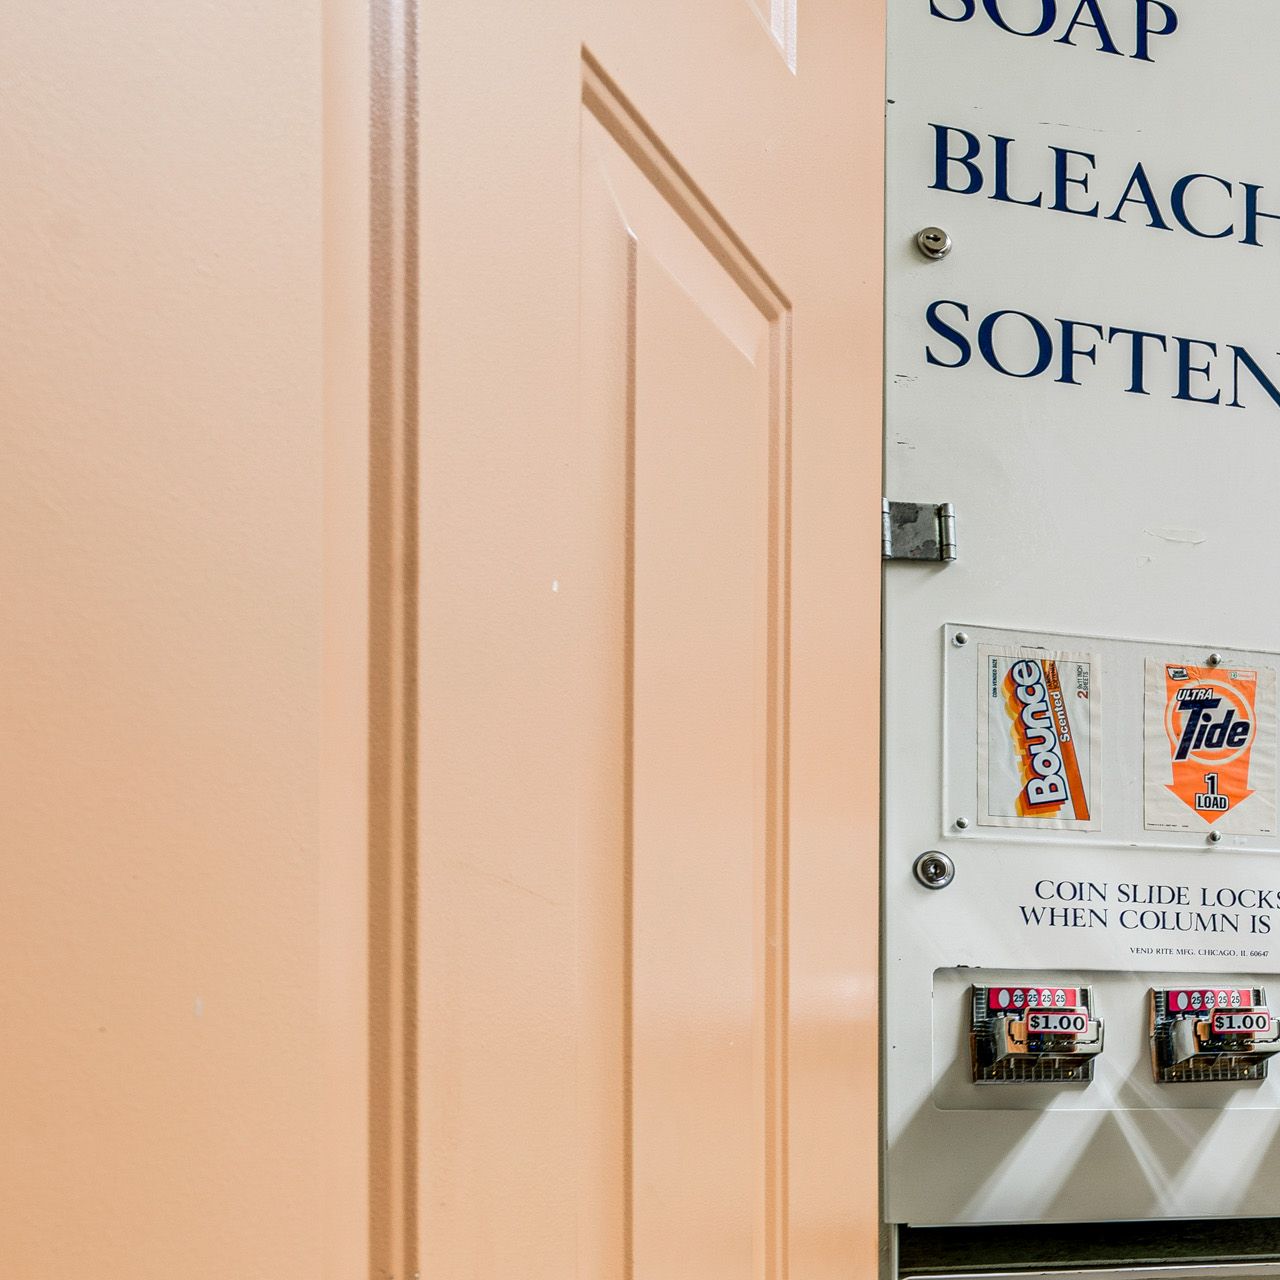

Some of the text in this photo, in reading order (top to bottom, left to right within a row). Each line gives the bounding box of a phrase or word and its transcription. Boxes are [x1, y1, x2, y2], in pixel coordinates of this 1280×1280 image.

[1077, 690, 1089, 699] 2
[1176, 689, 1213, 701] ULTRA
[1051, 690, 1070, 743] Scented
[1010, 658, 1069, 806] Bounce
[1175, 698, 1251, 761] Tide
[1205, 773, 1217, 795] 1
[1197, 795, 1228, 809] LOAD
[1034, 879, 1109, 903] COIN
[1117, 884, 1190, 906] SLIDE
[1019, 905, 1109, 929] WHEN
[1119, 909, 1240, 933] COLUMN
[1249, 914, 1271, 934] IS
[1130, 947, 1153, 955] VEND
[1013, 993, 1066, 1003] 25 25 25 25
[1191, 995, 1241, 1005] 25 25 25 25
[1029, 1013, 1087, 1033] $1.00
[1214, 1013, 1267, 1032] $1.00
